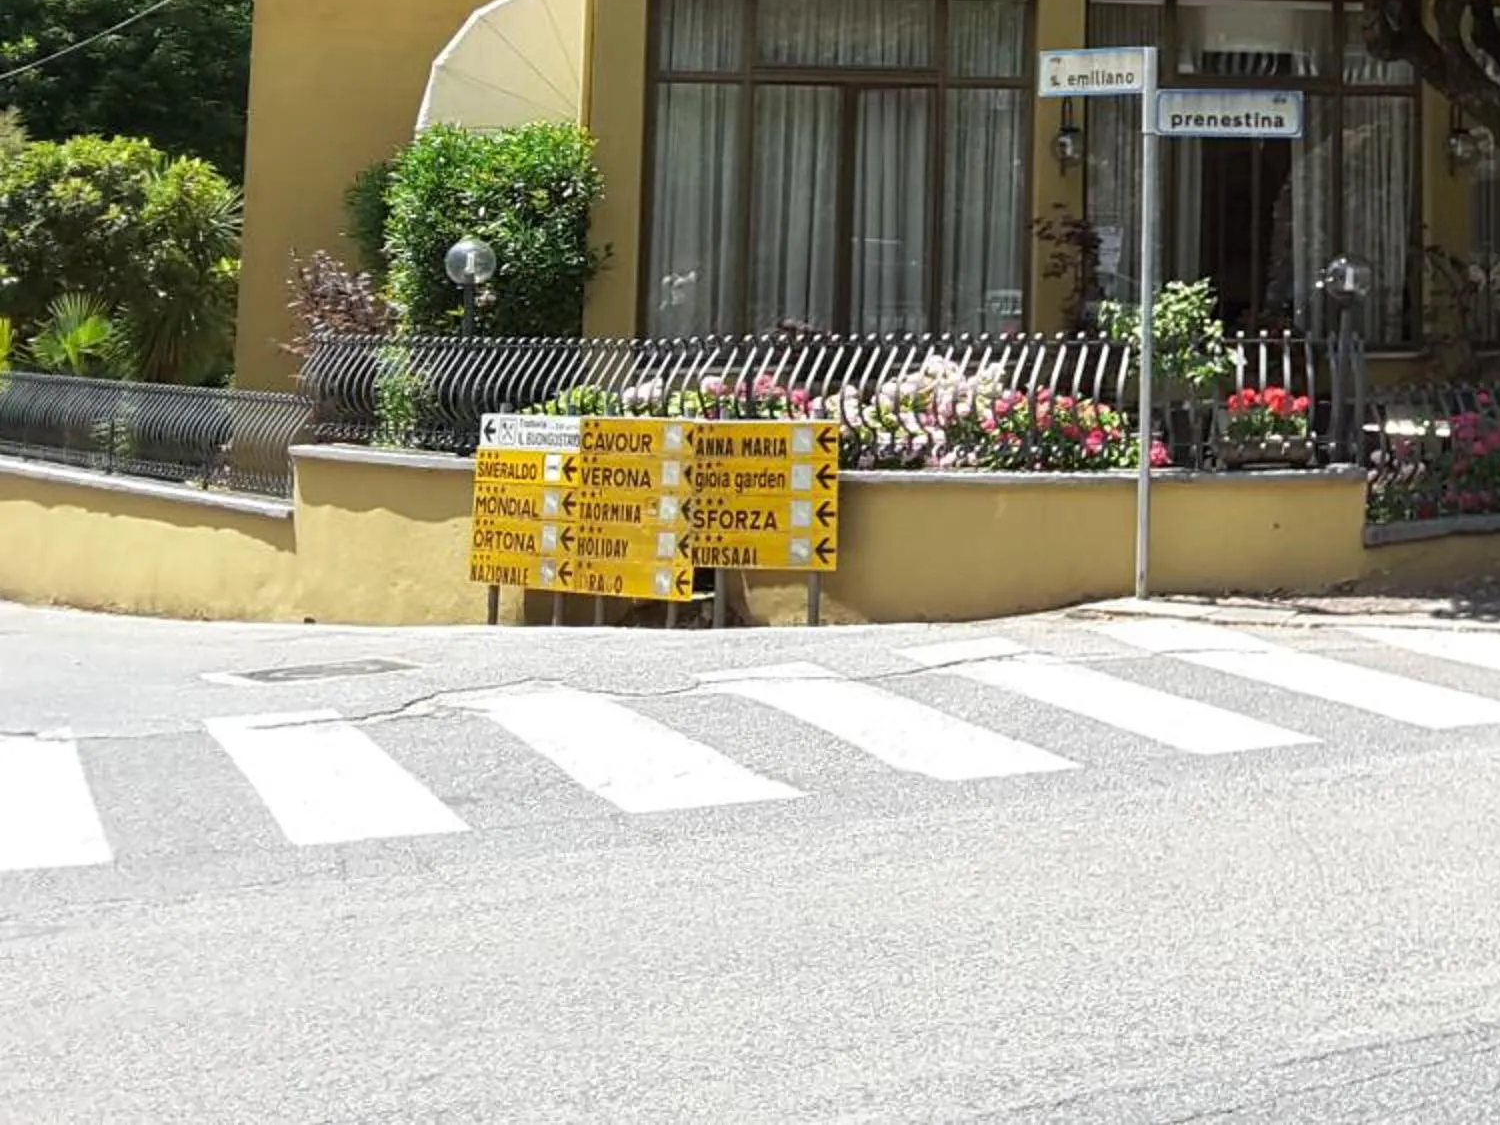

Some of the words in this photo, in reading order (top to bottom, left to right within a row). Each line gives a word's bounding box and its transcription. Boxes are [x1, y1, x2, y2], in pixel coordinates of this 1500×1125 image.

[1067, 69, 1134, 88] emiliano
[1171, 112, 1285, 129] prenestina
[581, 431, 653, 454] CAVOUR
[695, 436, 734, 457] ANNA
[741, 437, 788, 458] MARIA
[478, 460, 539, 481] SMERALDO
[580, 466, 653, 489] VERONA
[695, 469, 730, 493] gioia
[735, 468, 786, 493] garden
[475, 495, 539, 519] MONDIAL
[579, 501, 642, 524] TAORMINA
[692, 508, 778, 532] SFORZA
[472, 528, 537, 553] ORTONA
[577, 537, 629, 559] HOLIDAY
[691, 545, 758, 567] KURSAAL
[470, 561, 529, 585] NAZIONALE
